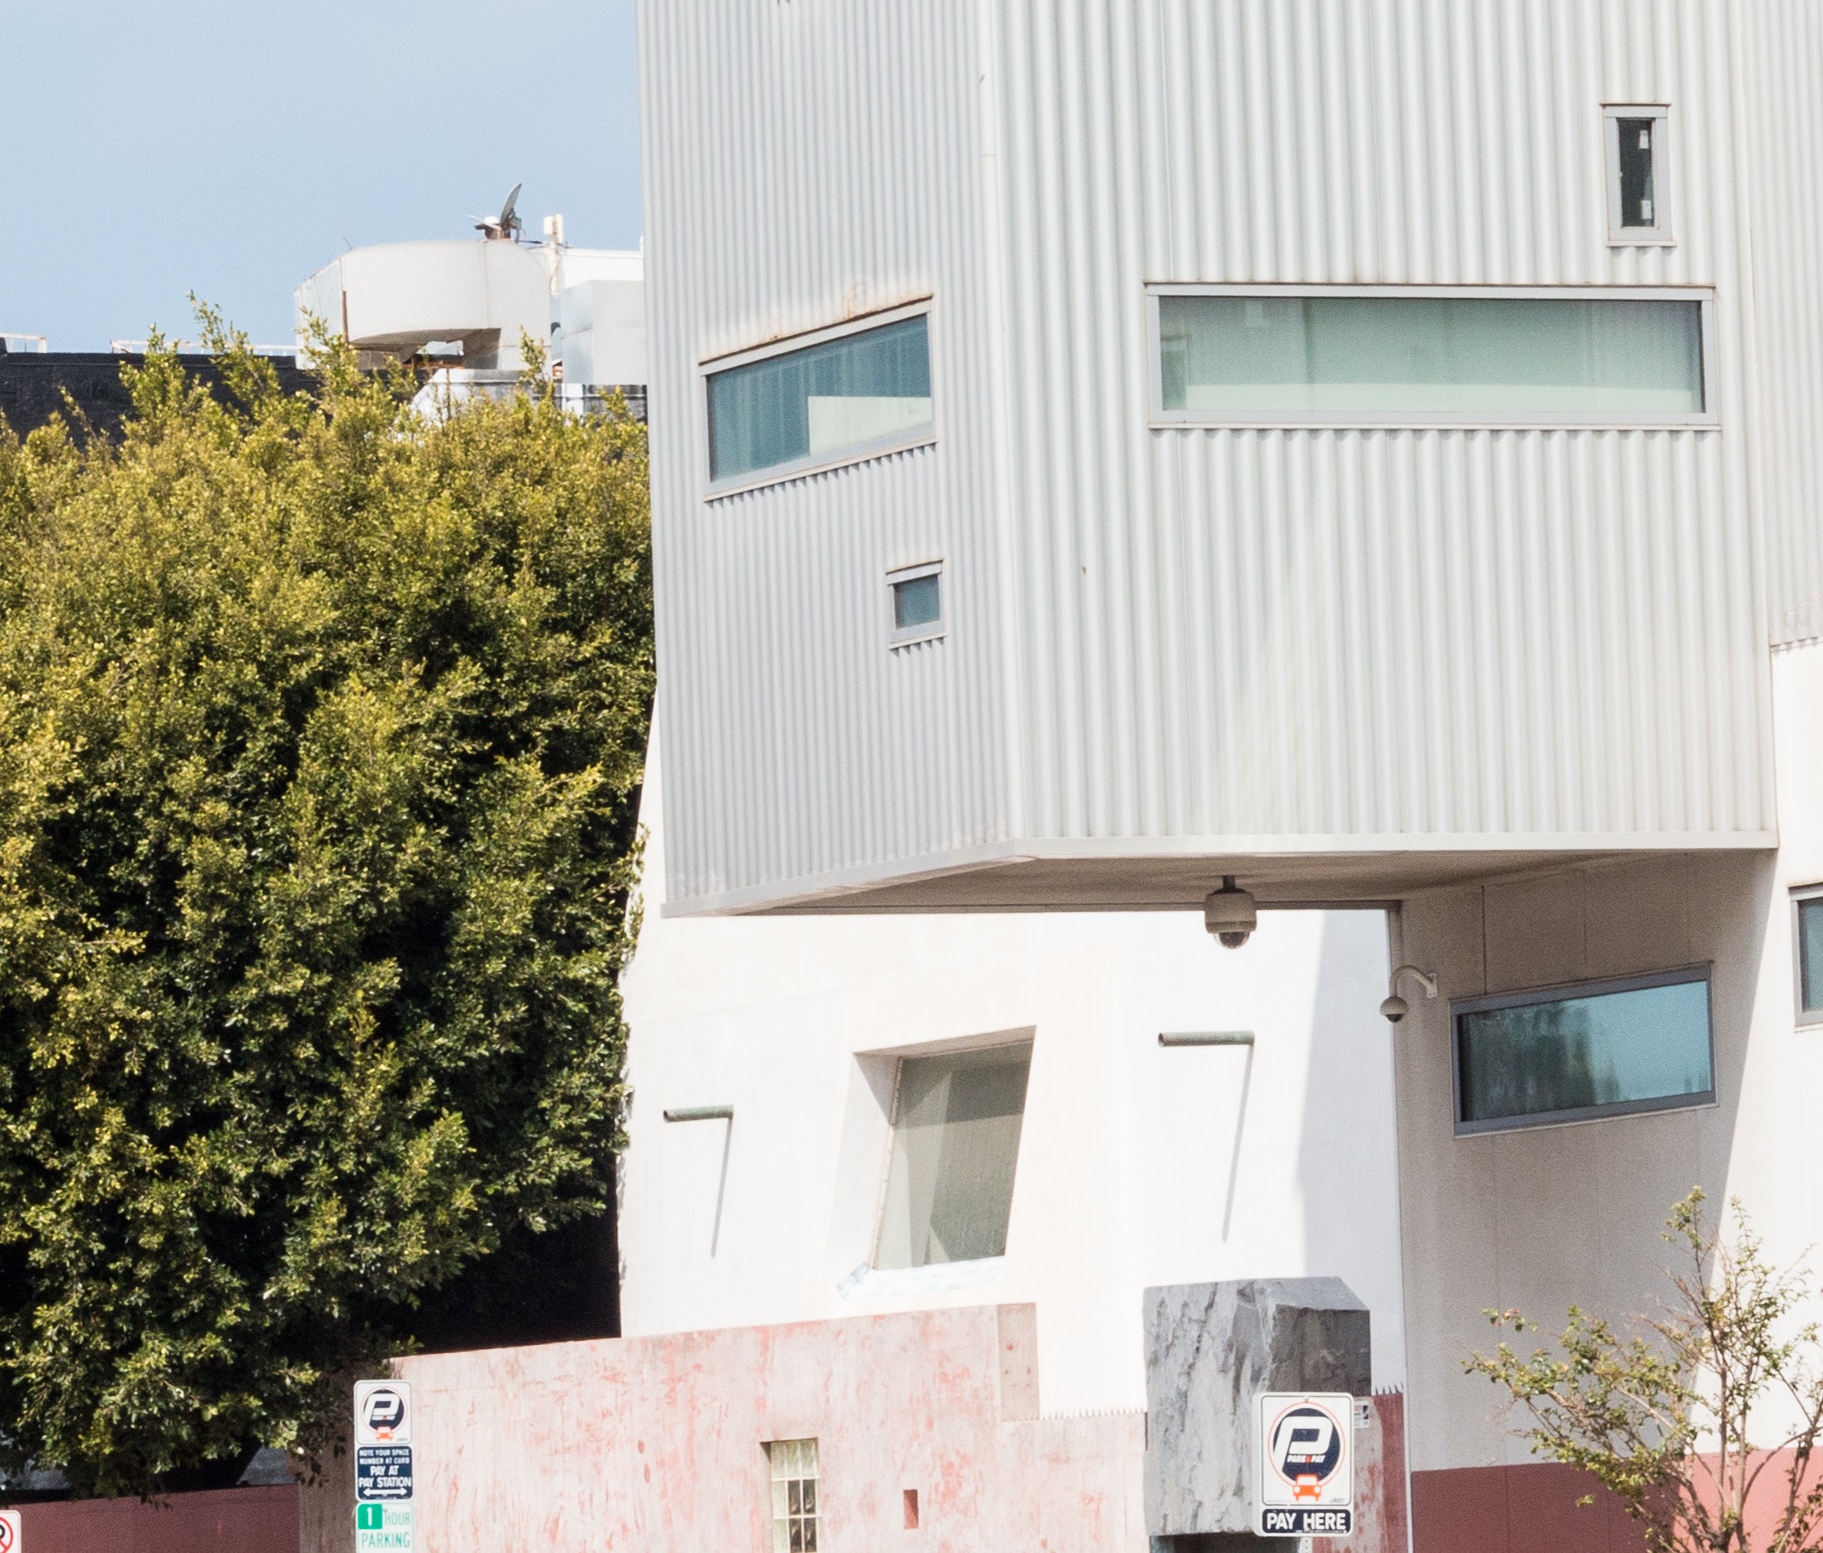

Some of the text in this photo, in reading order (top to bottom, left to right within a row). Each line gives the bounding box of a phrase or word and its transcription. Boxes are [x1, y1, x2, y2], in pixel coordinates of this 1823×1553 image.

[370, 1465, 400, 1476] PAY AT
[358, 1477, 412, 1488] PAY STATION
[366, 1506, 411, 1527] 1 HOUR
[1266, 1513, 1346, 1530] PAY HERE
[361, 1533, 410, 1548] PARKING
